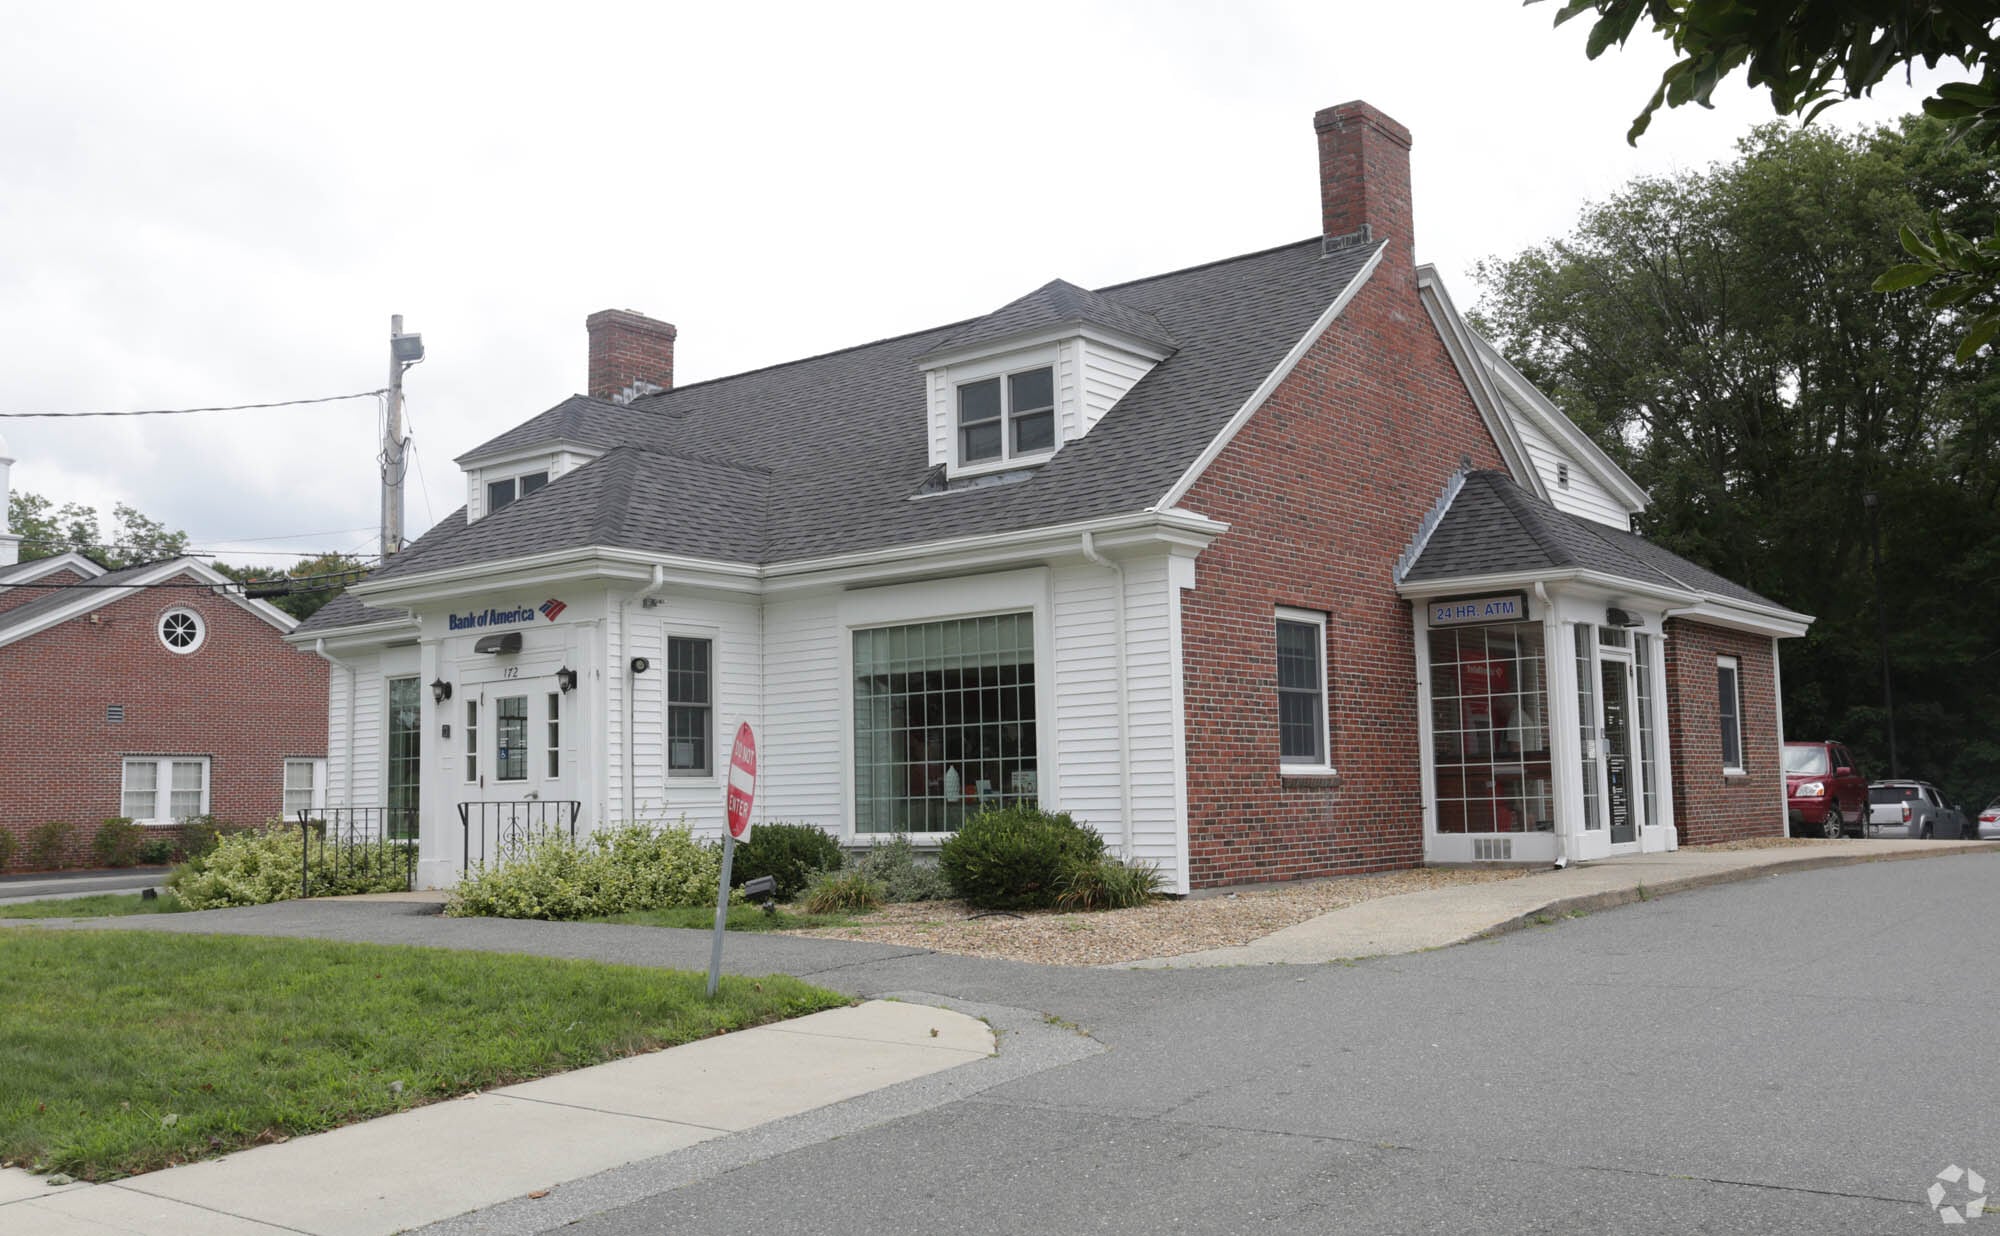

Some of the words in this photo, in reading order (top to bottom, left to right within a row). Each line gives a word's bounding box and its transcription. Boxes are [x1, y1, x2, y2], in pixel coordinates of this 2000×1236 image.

[449, 612, 476, 630] Bank
[477, 609, 488, 626] of
[489, 605, 535, 625] America
[1437, 607, 1452, 620] 24
[1456, 605, 1480, 618] HR.
[1485, 601, 1514, 616] ATM
[504, 666, 519, 678] 172
[735, 740, 743, 758] DO
[743, 744, 754, 765] NOT
[729, 794, 749, 817] ENTER
